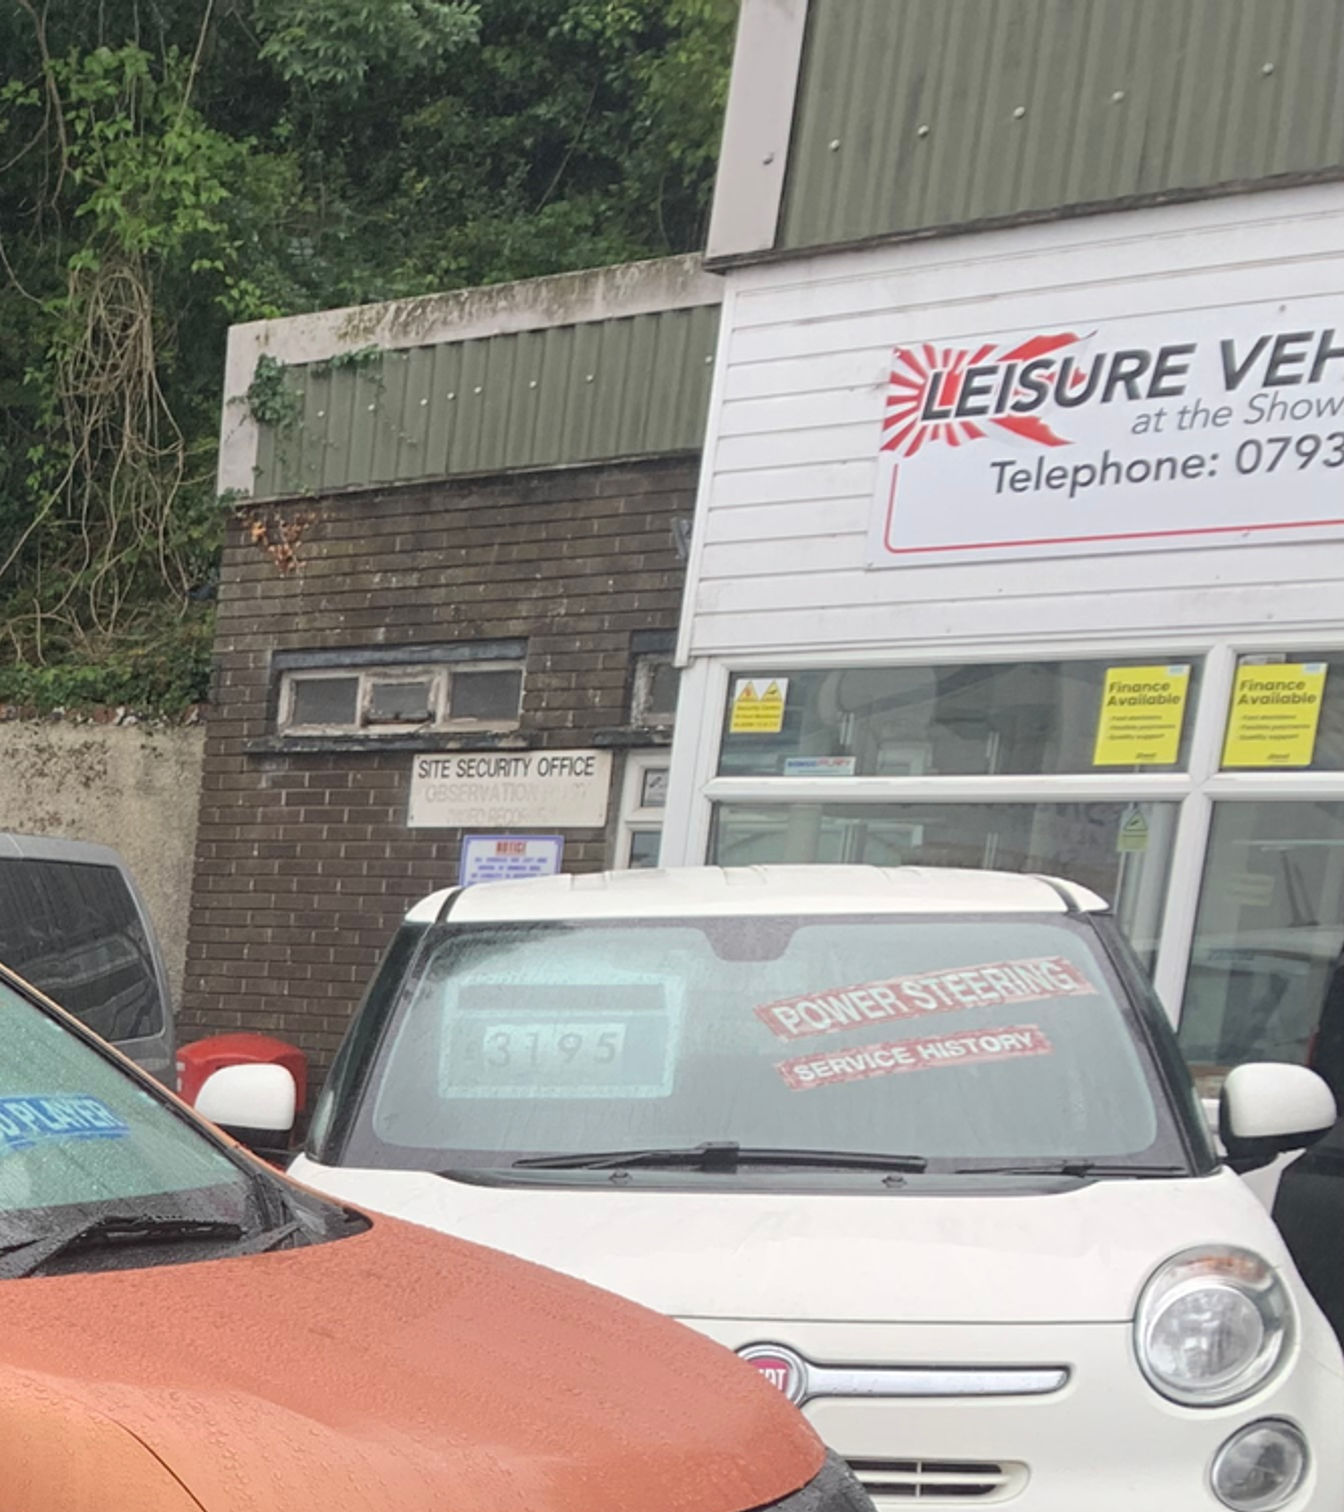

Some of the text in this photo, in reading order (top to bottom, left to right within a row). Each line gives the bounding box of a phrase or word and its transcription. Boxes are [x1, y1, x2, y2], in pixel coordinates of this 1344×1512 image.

[921, 343, 1197, 422] LEISURE
[1130, 407, 1167, 435] at
[1176, 398, 1233, 431] the
[990, 449, 1219, 498] Telephone:
[1107, 692, 1182, 706] Available
[1109, 681, 1172, 694] Finance
[1237, 691, 1317, 706] Available
[1239, 679, 1307, 692] Finance
[418, 755, 596, 779] SITE SECURITY OFFICE
[772, 960, 1081, 1035] POWER STEERING
[793, 1030, 1035, 1083] SERVICE HISTORY
[4, 1099, 126, 1133] PLAYER
